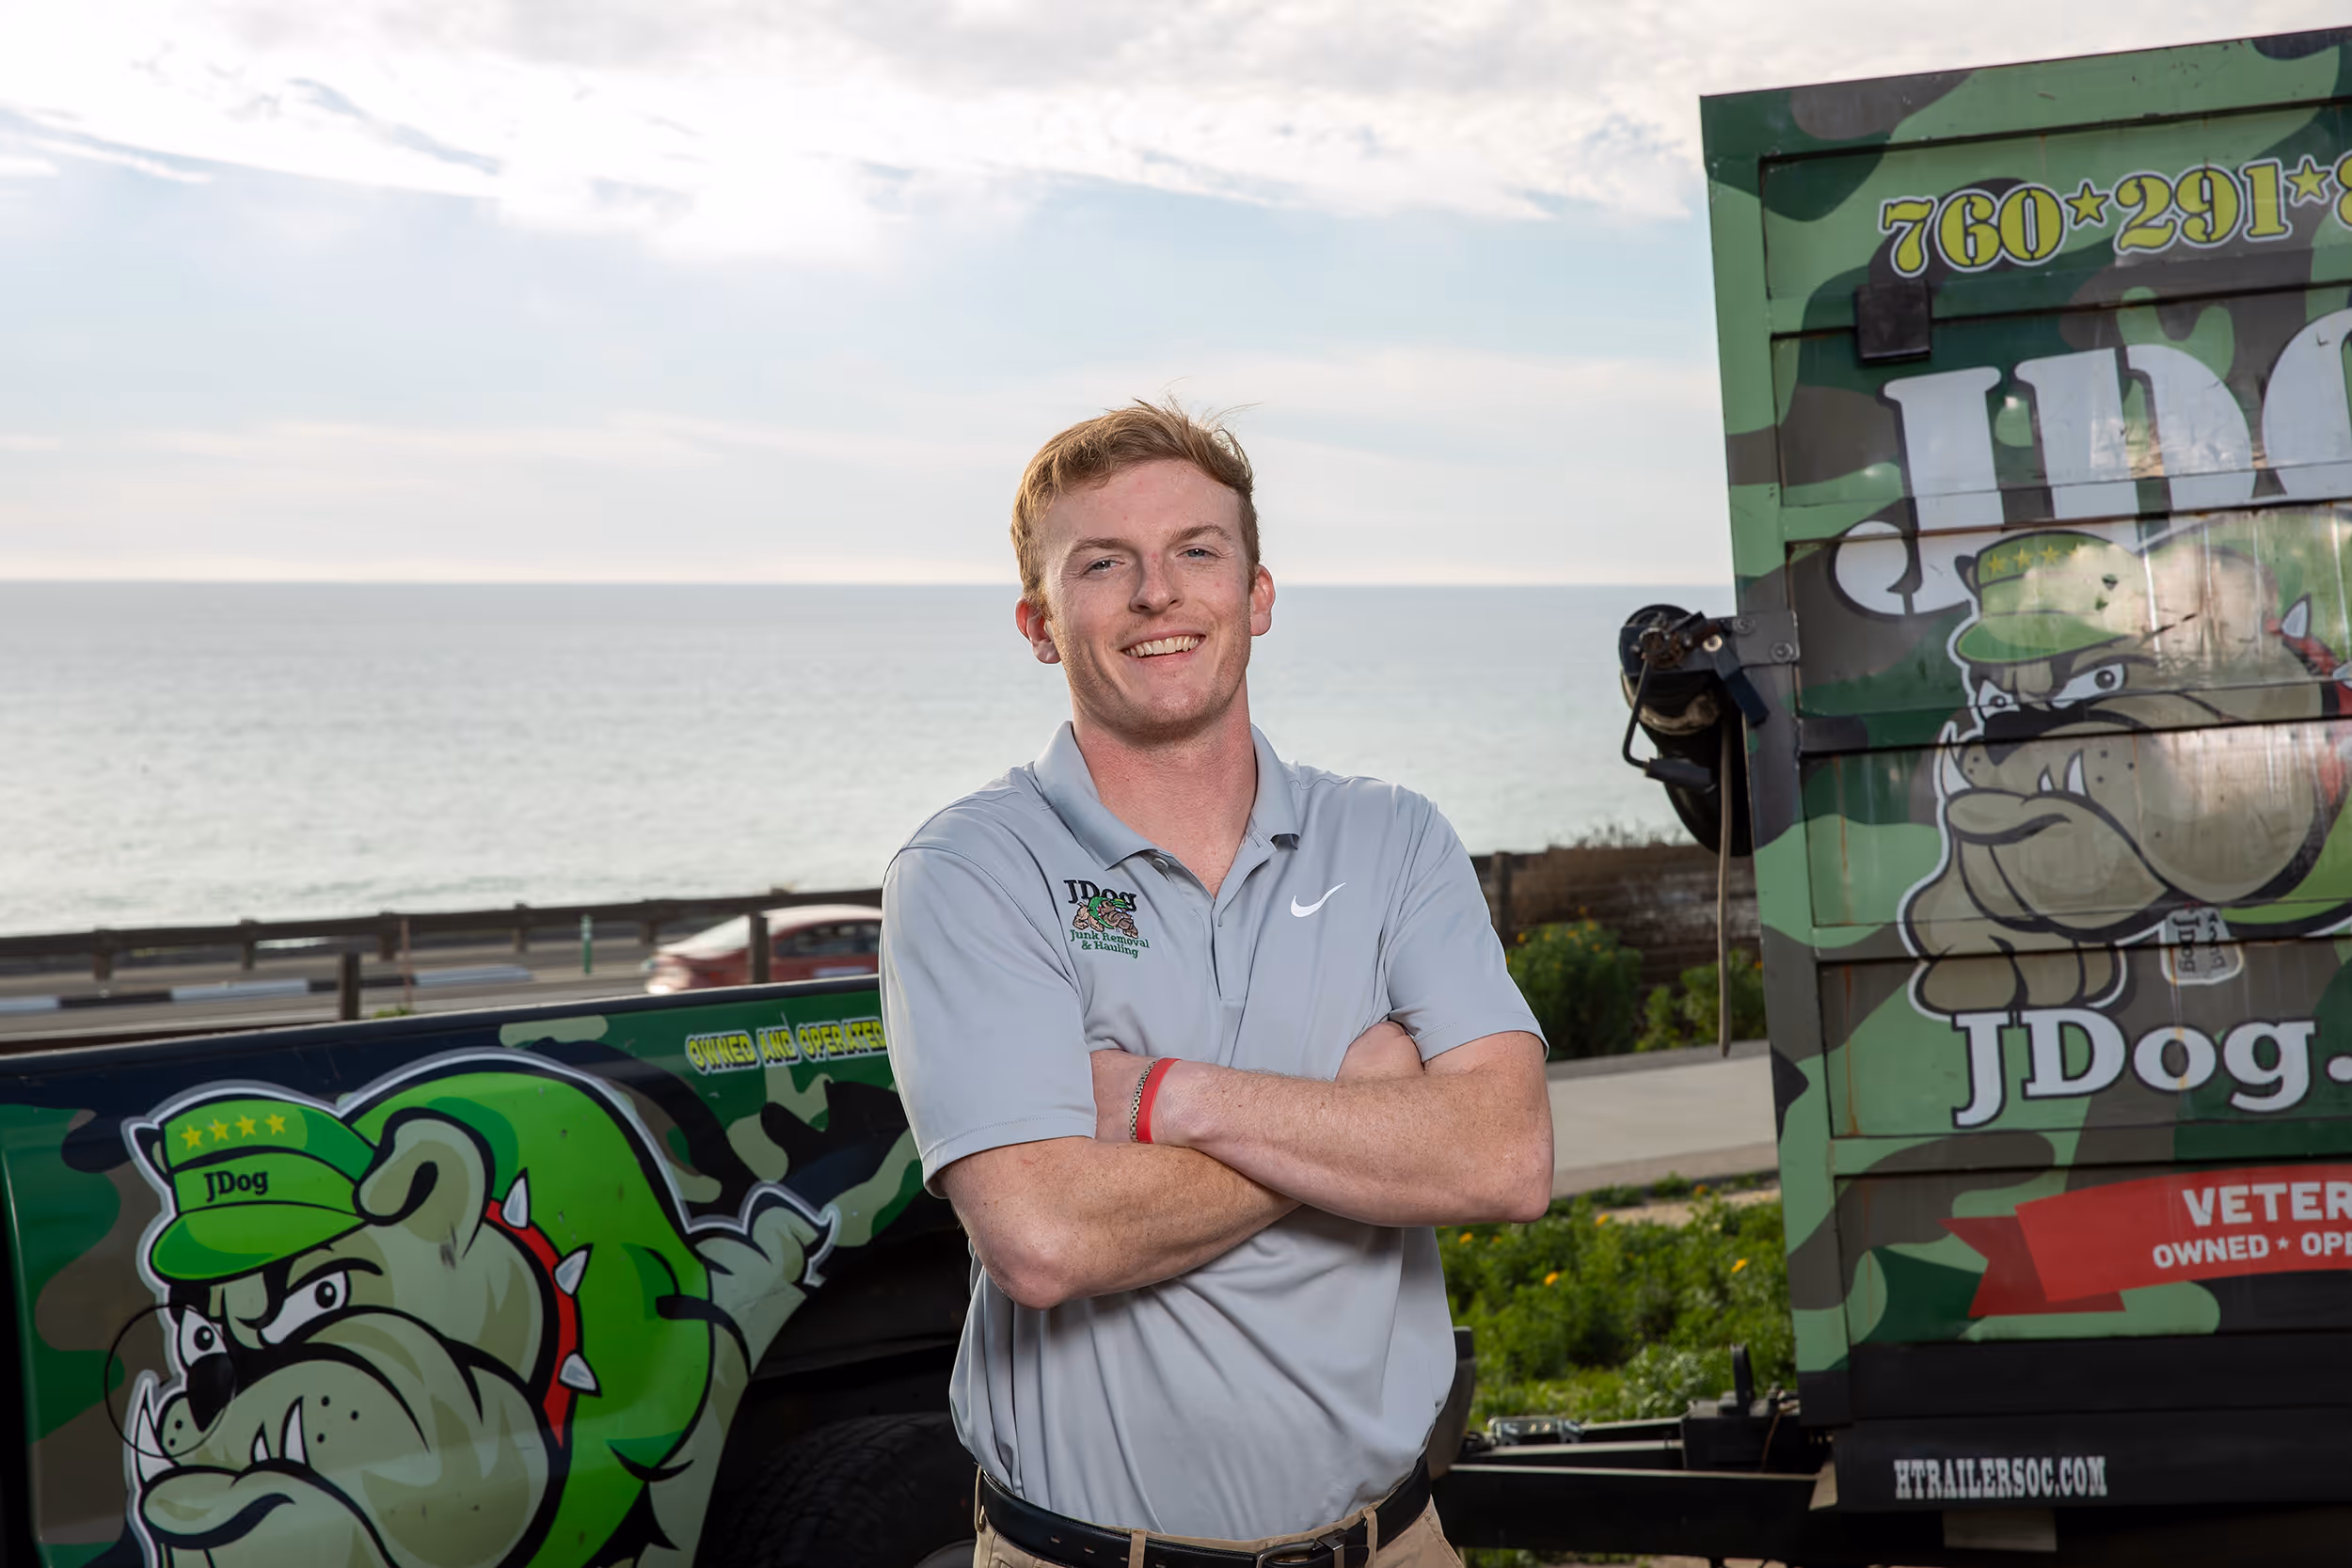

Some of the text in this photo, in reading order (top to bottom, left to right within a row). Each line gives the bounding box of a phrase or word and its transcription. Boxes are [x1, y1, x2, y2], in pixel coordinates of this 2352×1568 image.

[1063, 879, 1137, 912] JDog
[1070, 929, 1150, 948] Junk Removal
[1081, 941, 1138, 958] & Hauling
[687, 1019, 887, 1072] OWNED AND OPERATED
[203, 1170, 268, 1203] JDog
[2153, 1234, 2269, 1269] OWNED
[1894, 1456, 2107, 1499] HTRAILERSOC.COM
